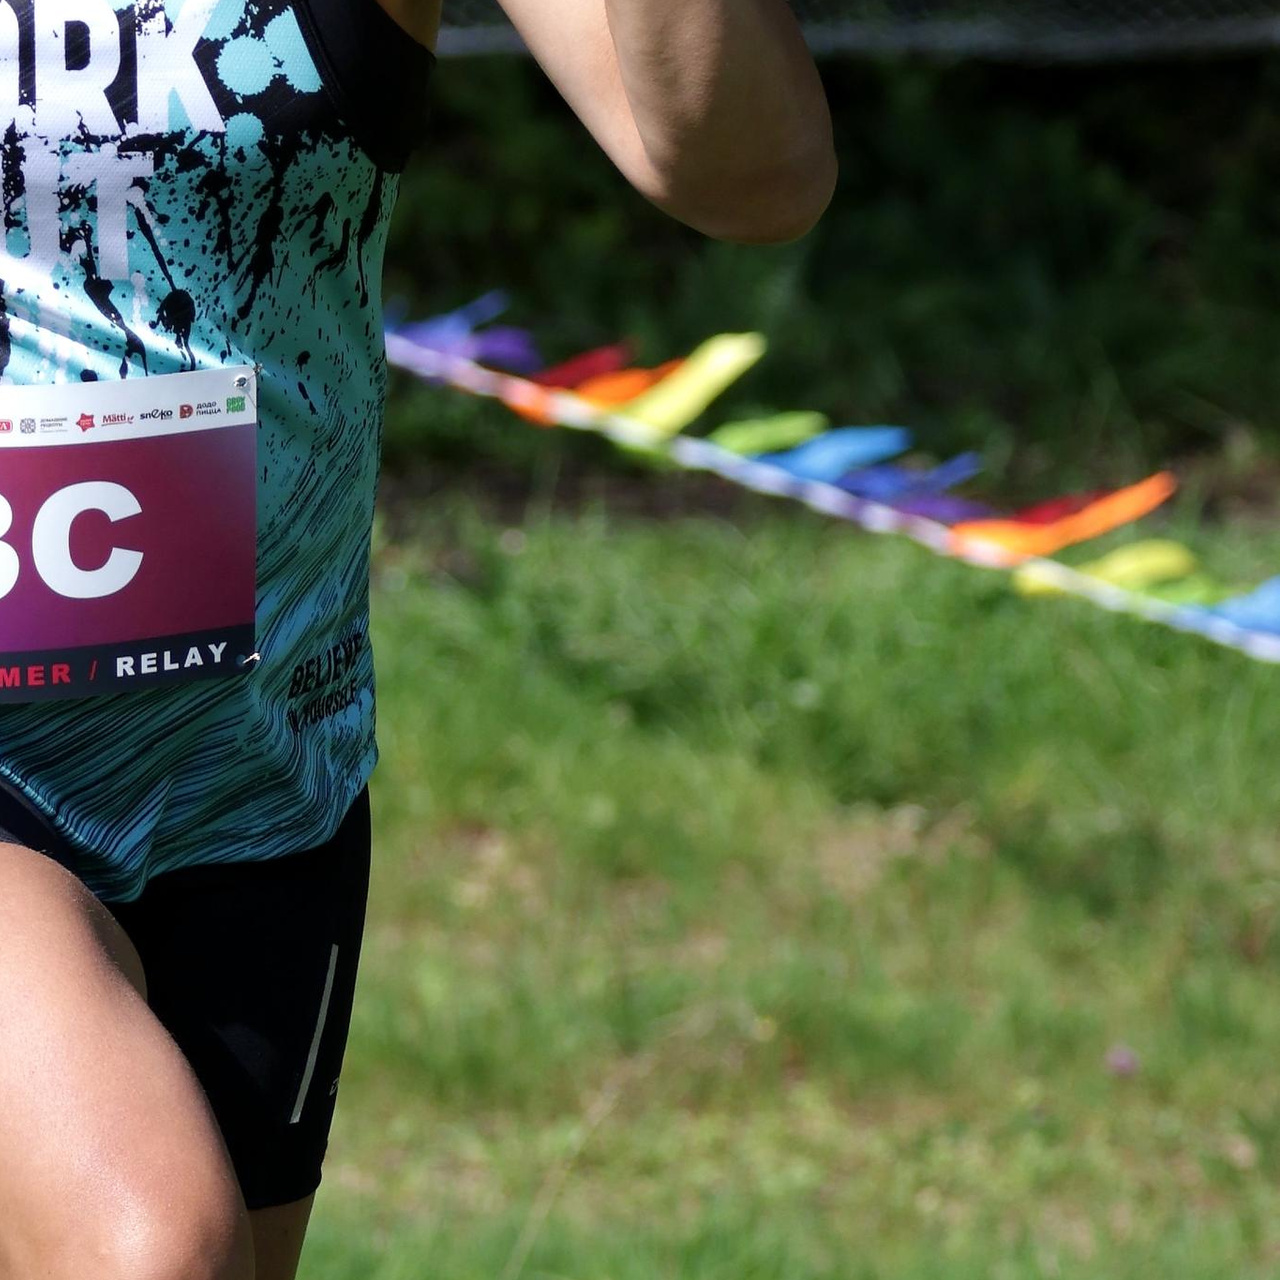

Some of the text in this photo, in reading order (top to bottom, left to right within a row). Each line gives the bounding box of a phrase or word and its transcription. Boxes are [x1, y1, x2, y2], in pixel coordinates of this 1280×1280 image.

[102, 412, 126, 424] Mätti
[116, 642, 228, 678] RELAY
[287, 632, 363, 700] BELIEVE
[302, 678, 357, 727] YOURSELF
